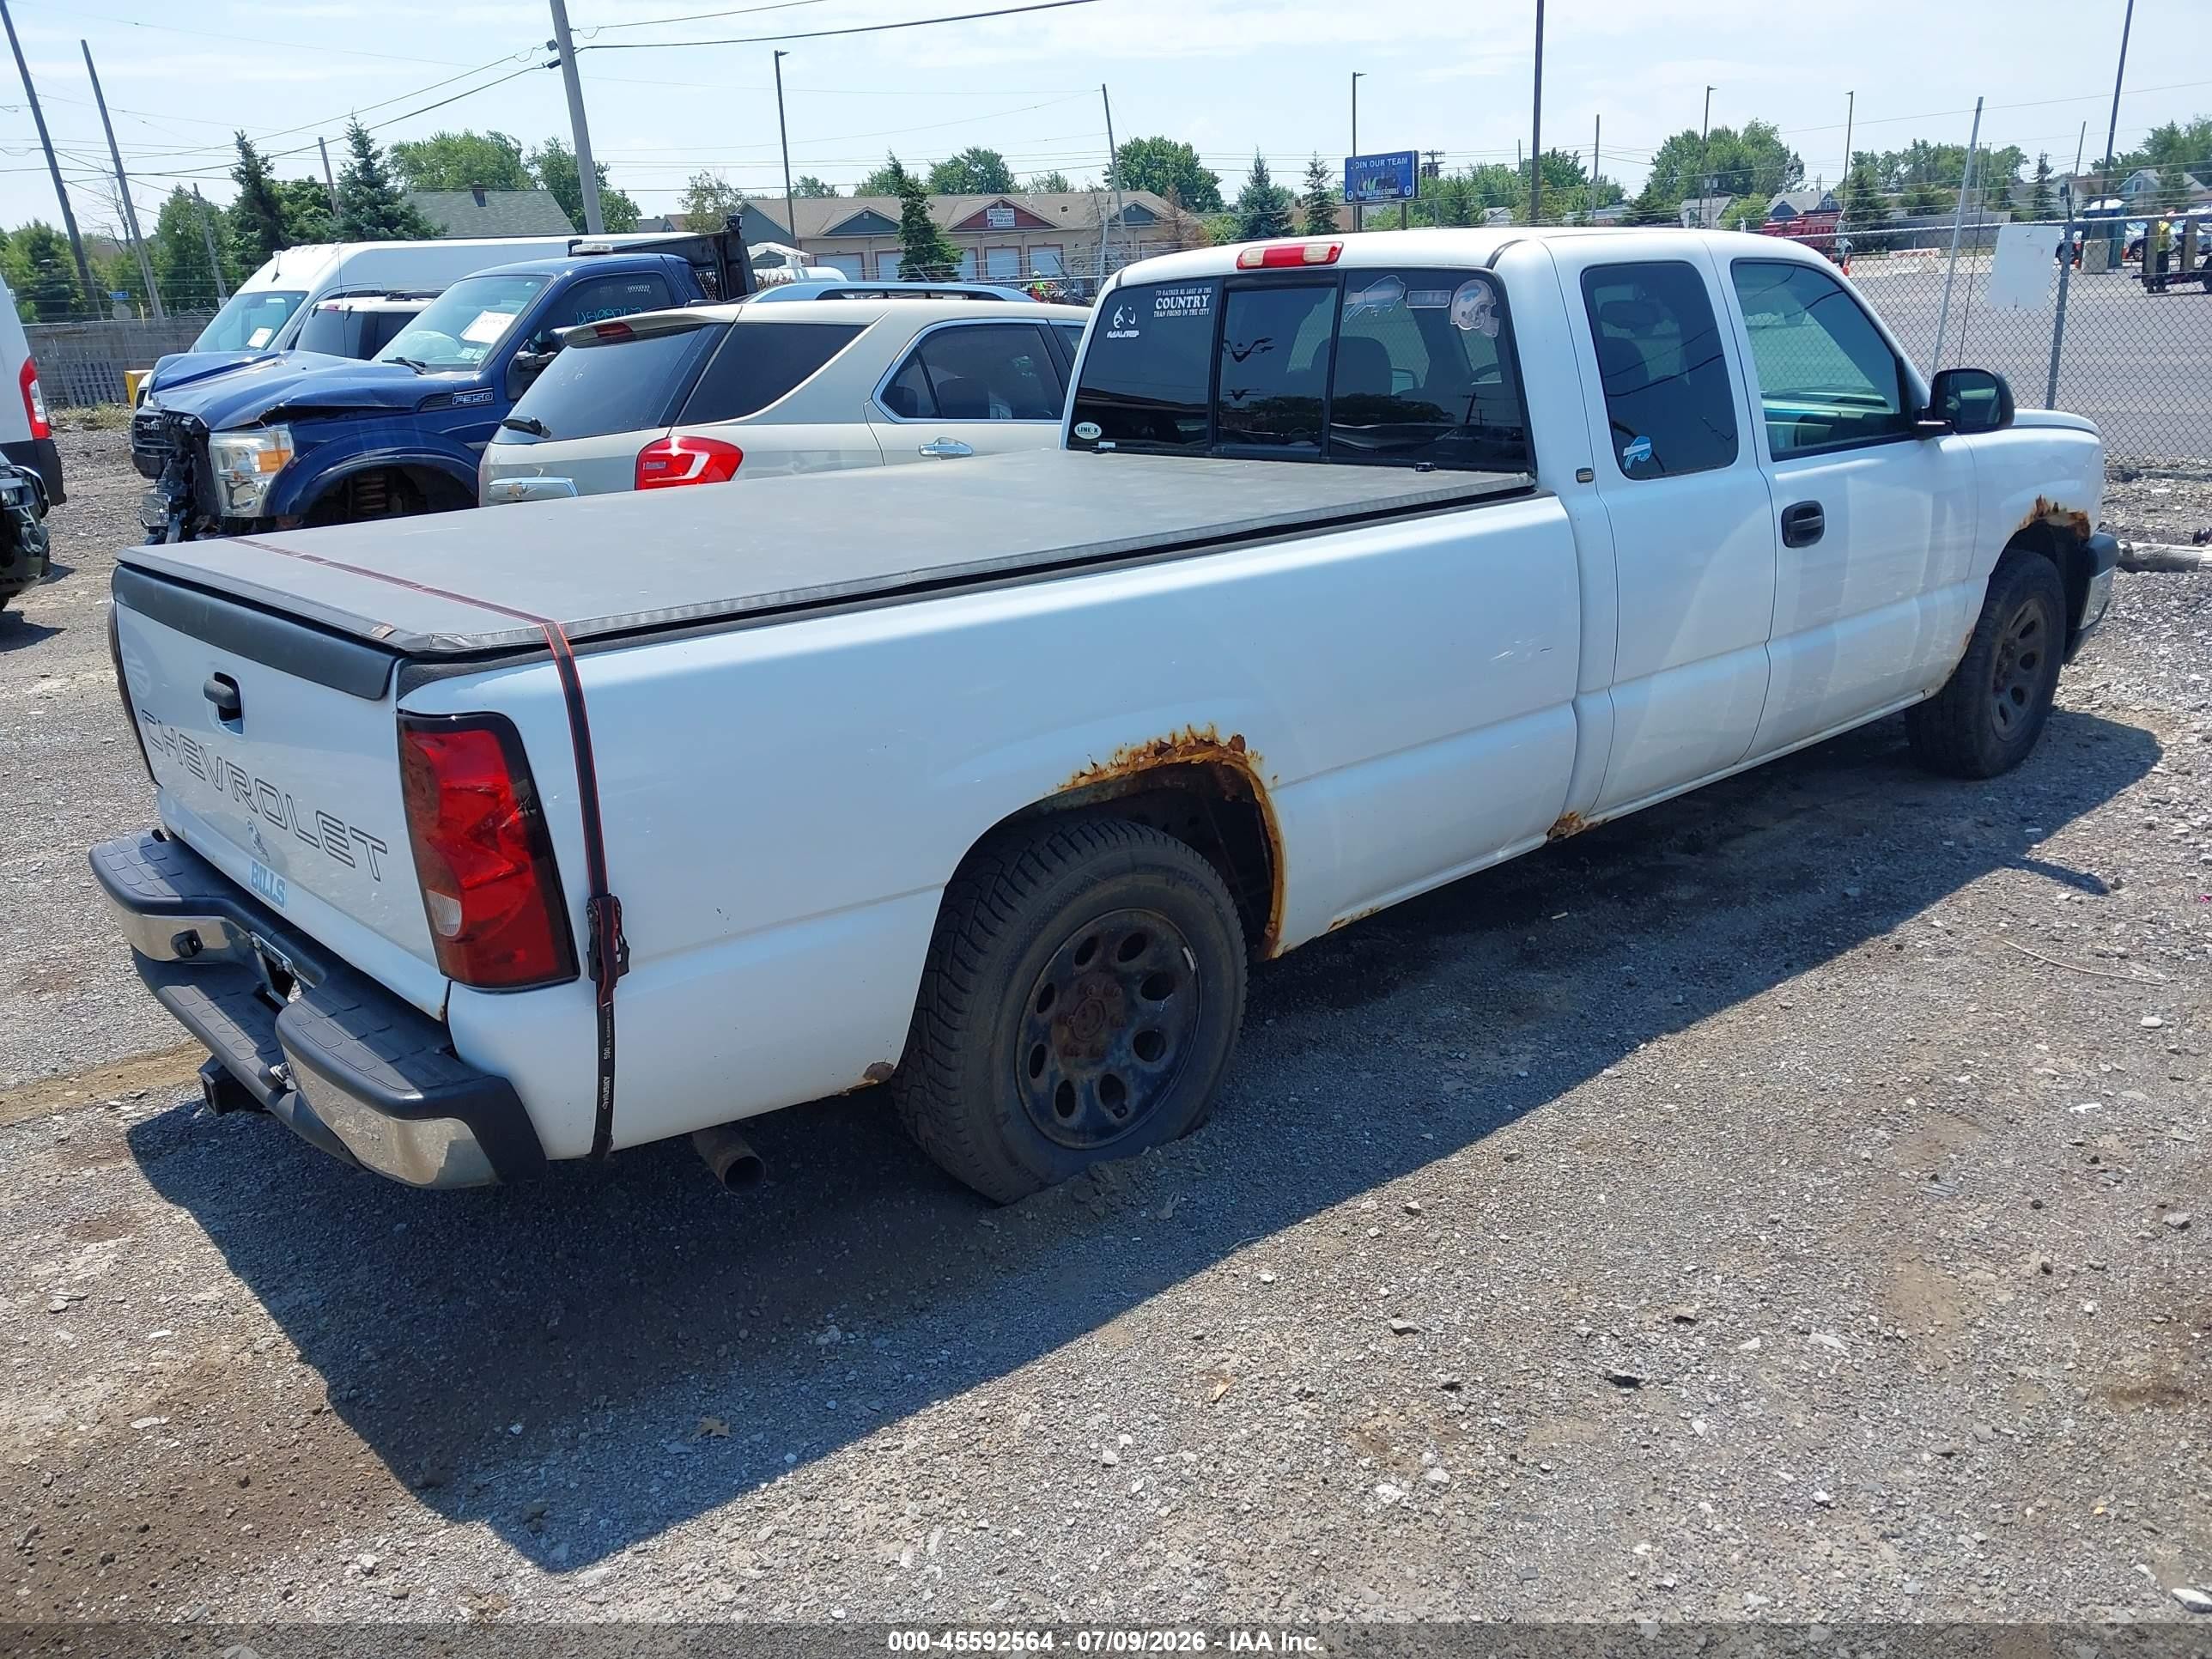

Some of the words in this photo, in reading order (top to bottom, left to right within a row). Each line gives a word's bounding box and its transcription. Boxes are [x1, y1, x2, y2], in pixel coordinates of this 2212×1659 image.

[1370, 158, 1385, 167] OUR
[1387, 157, 1408, 166] TEAM
[1155, 295, 1210, 310] COUNTRY
[141, 708, 388, 883] CHEVROLET
[251, 860, 286, 908] BILLS
